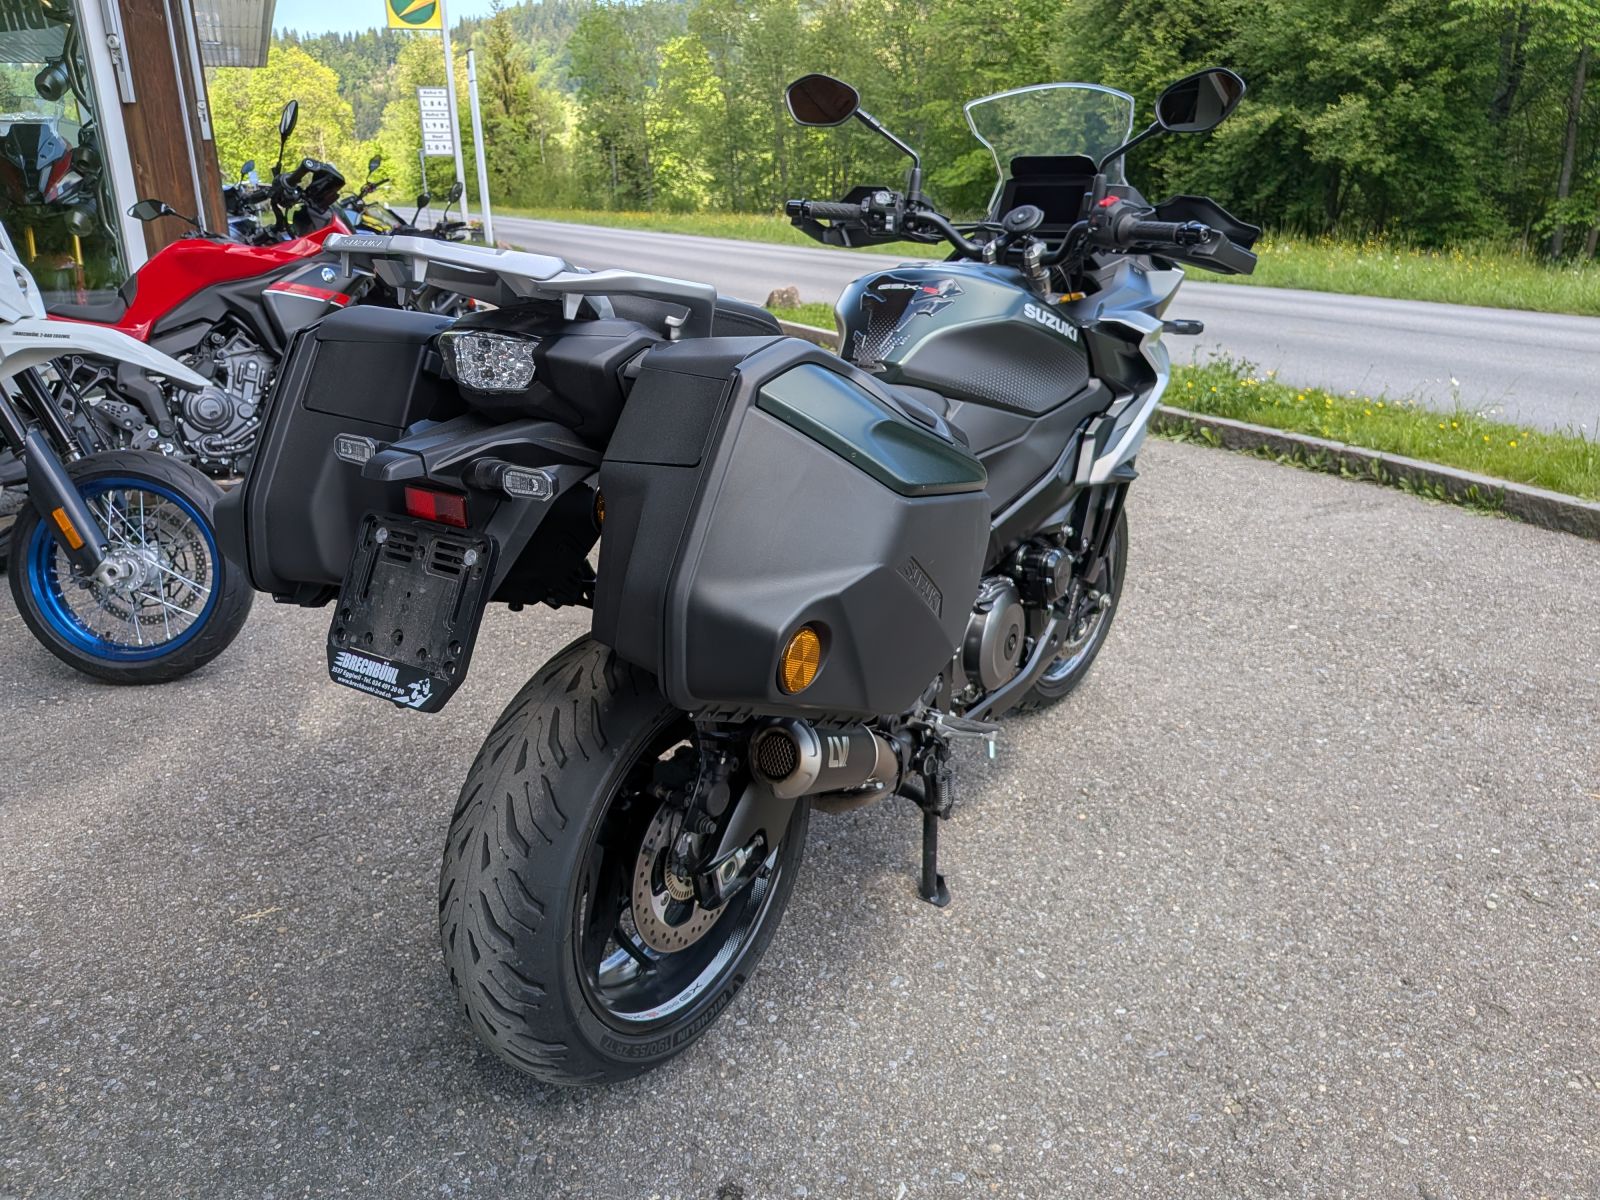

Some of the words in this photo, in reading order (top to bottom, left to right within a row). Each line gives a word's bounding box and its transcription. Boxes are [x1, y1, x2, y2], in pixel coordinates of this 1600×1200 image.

[1023, 302, 1078, 342] SUZUKI
[331, 666, 343, 674] 3537
[343, 669, 361, 681] Eggiwil
[364, 676, 372, 684] Tel.
[372, 679, 381, 687] 034
[341, 652, 399, 685] BRECHBÜHL
[677, 994, 728, 1043] MICHELIN
[631, 1037, 670, 1057] 190/55
